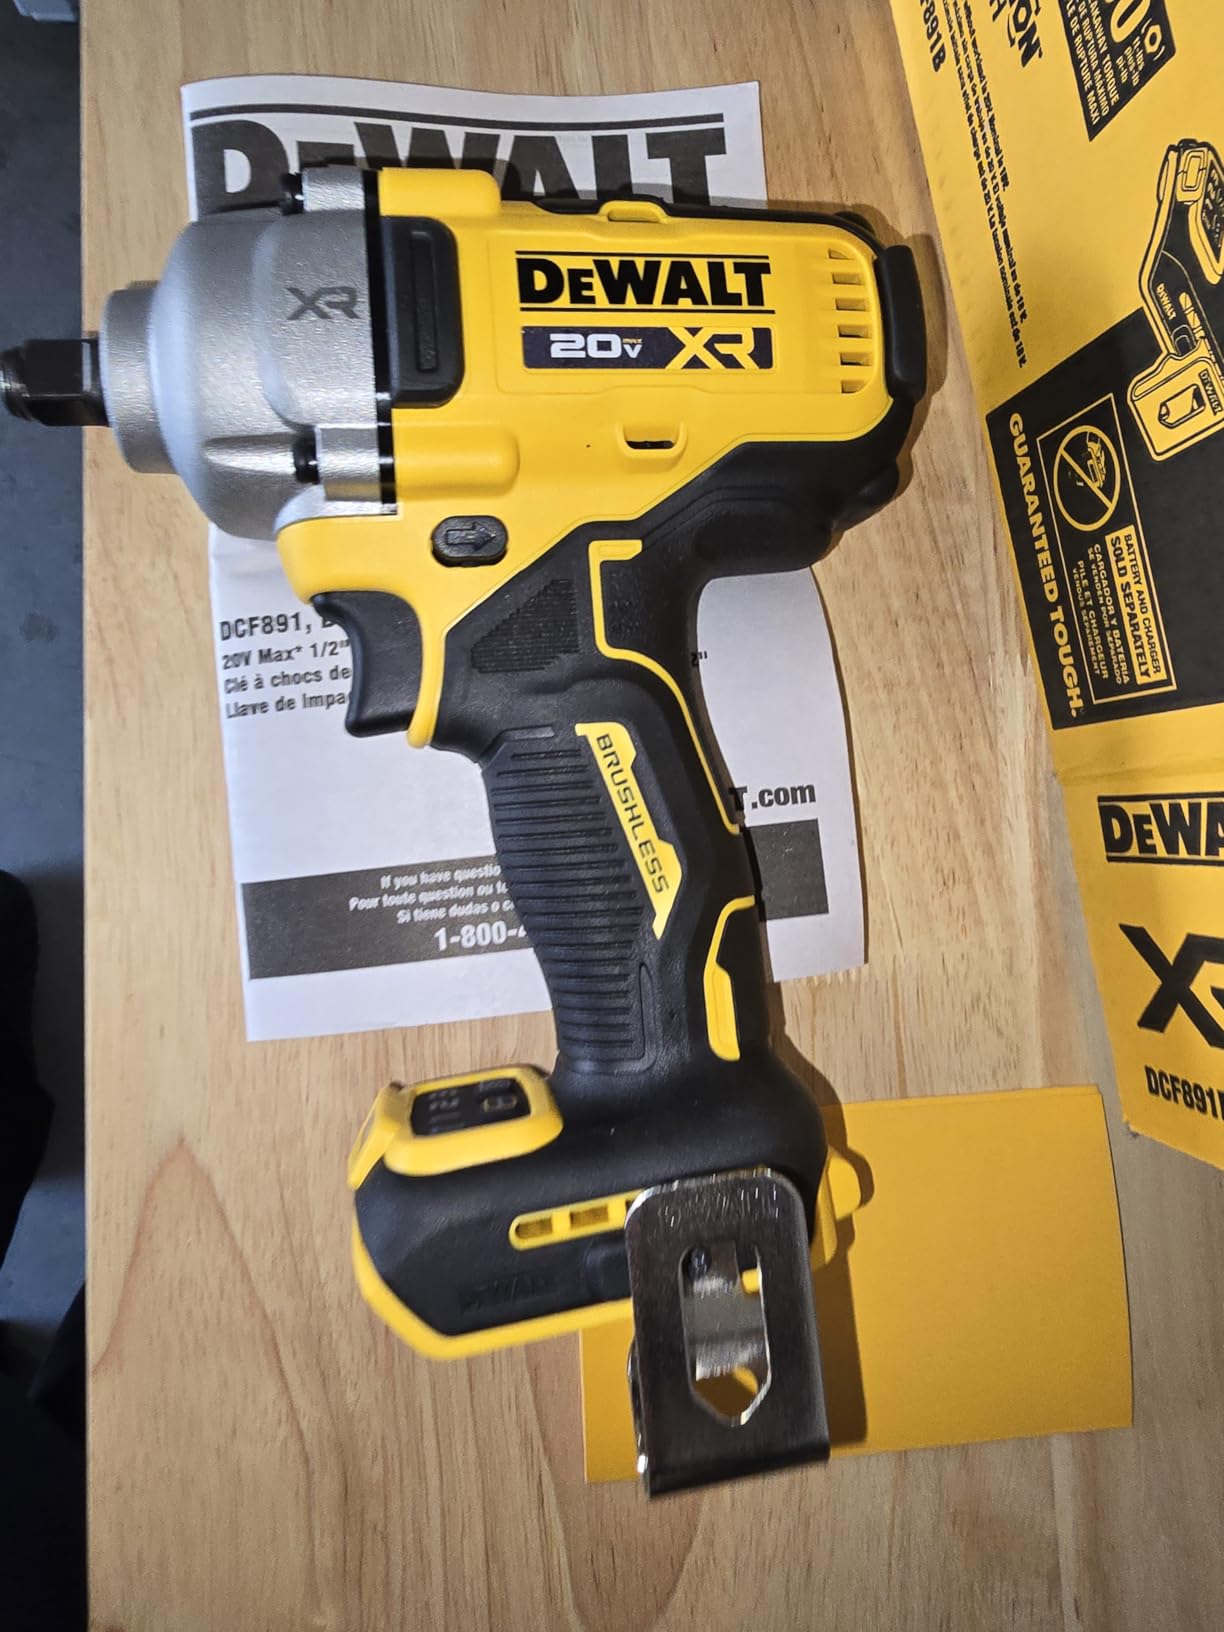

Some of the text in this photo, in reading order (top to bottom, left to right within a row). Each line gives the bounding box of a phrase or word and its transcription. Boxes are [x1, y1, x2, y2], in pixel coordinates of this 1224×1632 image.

[920, 0, 946, 72] 891B
[1009, 0, 1042, 68] ON
[1070, 16, 1080, 36] DE
[1082, 17, 1099, 71] RUPTURA
[1074, 34, 1092, 91] RUPTURE
[1101, 53, 1120, 106] TORQUE
[284, 286, 362, 321] XR
[665, 327, 761, 370] XR
[1009, 412, 1060, 602] GUARANTEED
[1094, 543, 1115, 615] CARGADOR
[1110, 617, 1118, 626] Y
[1111, 536, 1151, 678] SOLD SEPARATELY
[1124, 533, 1161, 675] BATTERY AND CHARGER
[1077, 560, 1109, 679] PILE ET CHARGEUR
[1091, 563, 1104, 604] VENDEN
[1105, 629, 1122, 685] SEPARADO
[222, 650, 252, 670] 20V
[224, 665, 352, 694] Clé à chocs de
[225, 691, 351, 719] Llave de Impa
[596, 733, 670, 893] BRUSHLESS
[349, 896, 380, 912] Pour
[382, 892, 416, 908] toute
[418, 885, 474, 904] question
[477, 883, 493, 896] ou
[393, 874, 418, 890] you
[420, 868, 451, 885] have
[397, 909, 411, 924] Si
[413, 906, 446, 922] tiene
[449, 901, 488, 917] dudas
[490, 901, 500, 912] o
